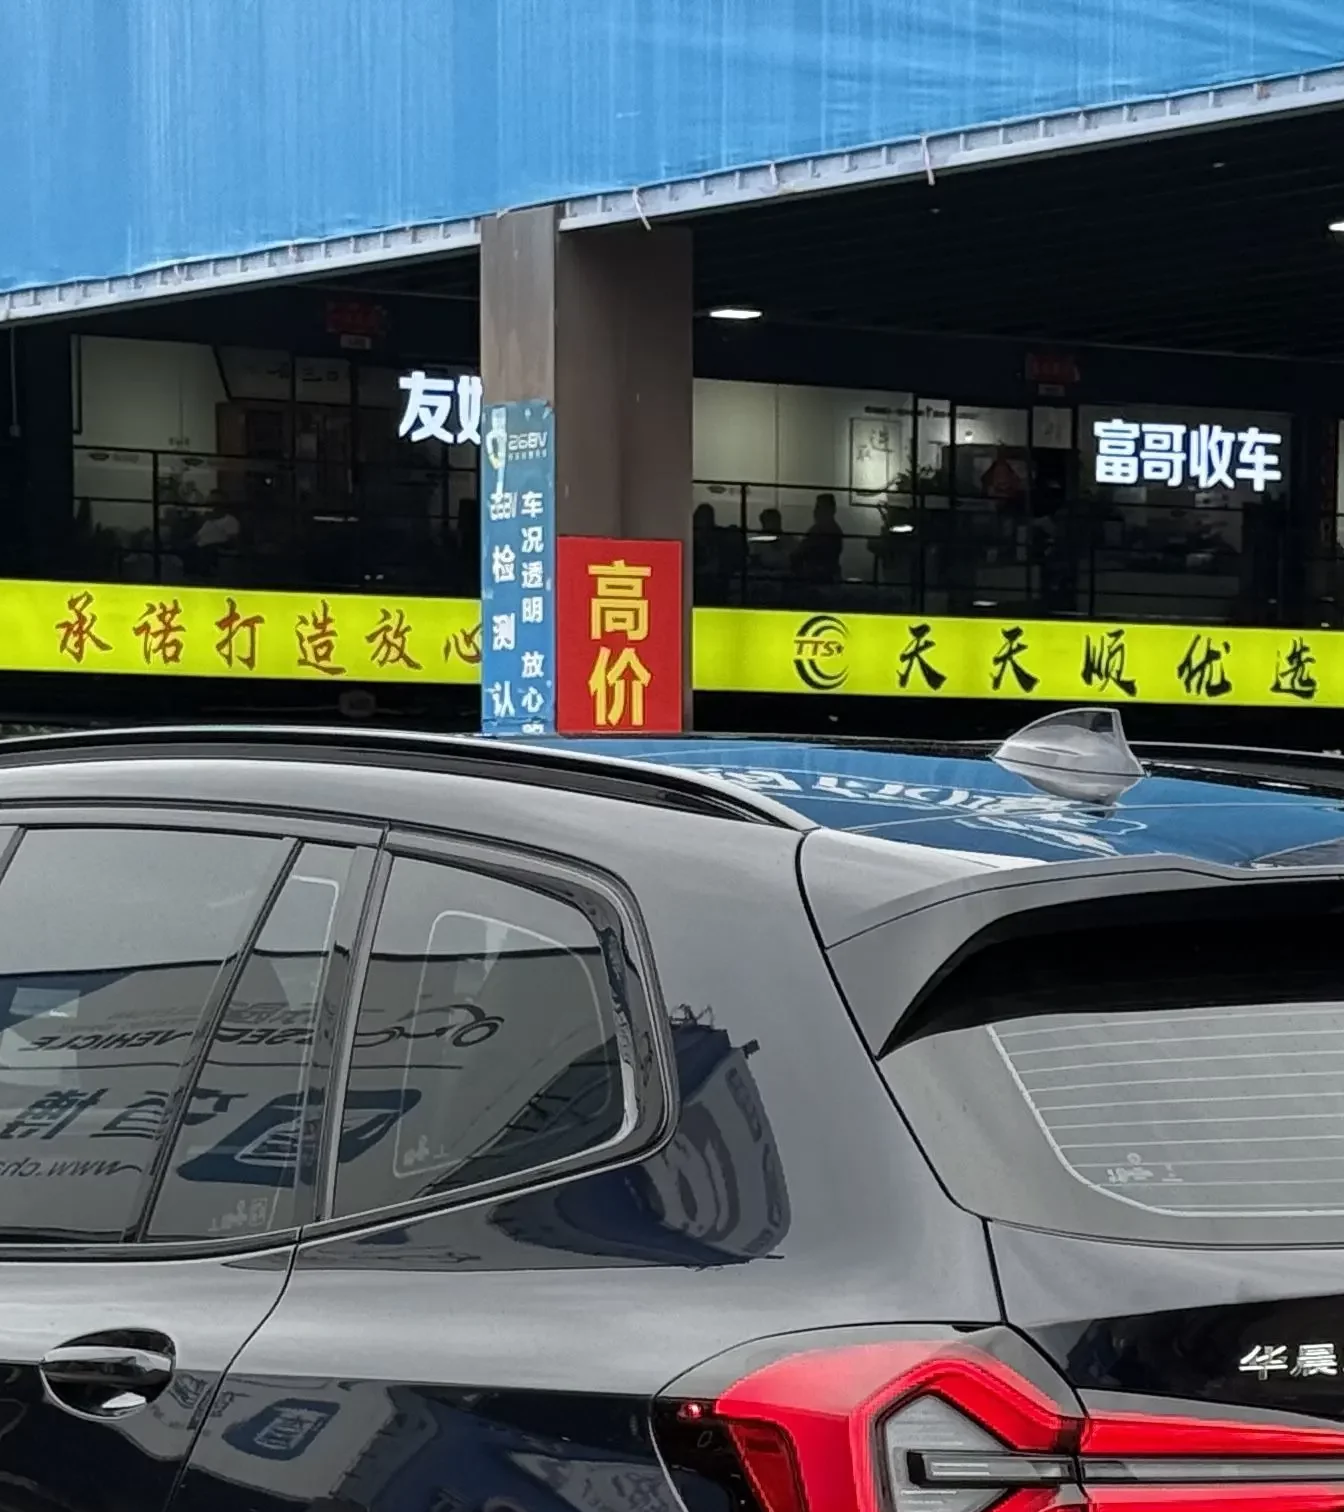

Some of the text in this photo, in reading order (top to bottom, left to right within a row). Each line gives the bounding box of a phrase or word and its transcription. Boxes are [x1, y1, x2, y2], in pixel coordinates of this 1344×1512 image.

[1093, 418, 1282, 492] 富哥收车
[587, 559, 652, 727] 高价
